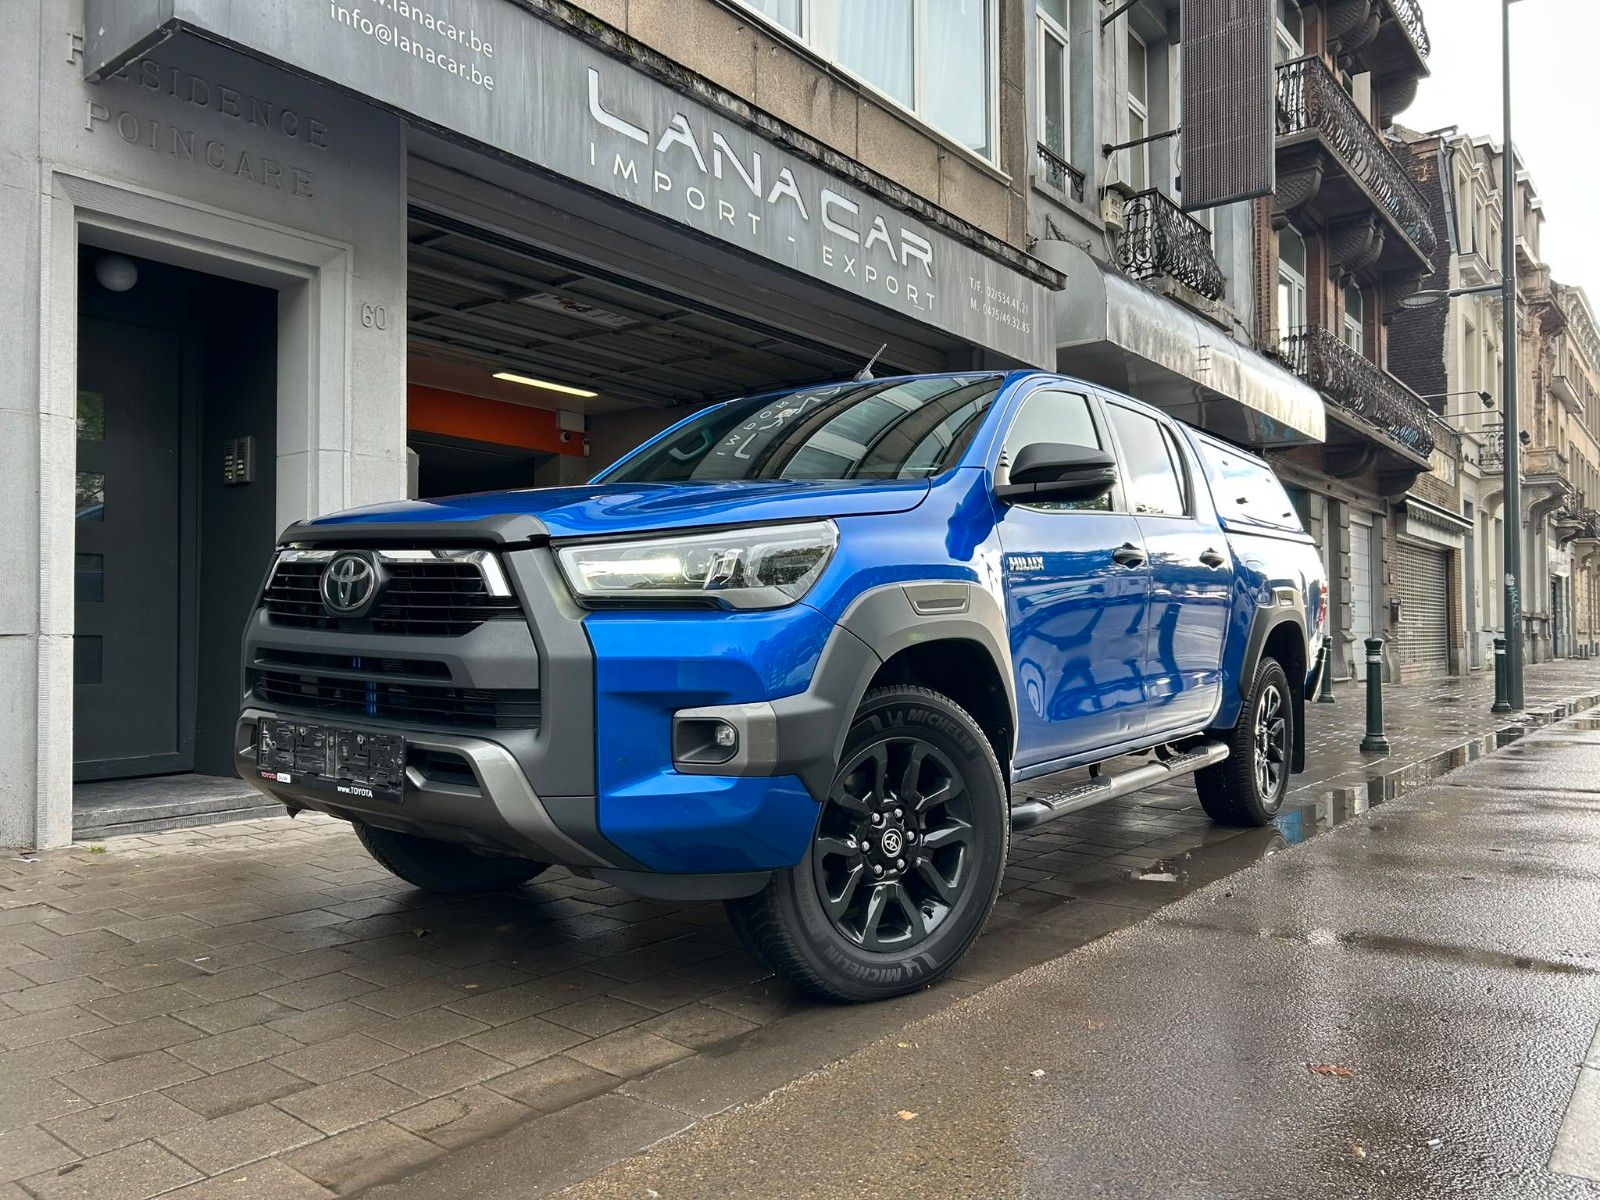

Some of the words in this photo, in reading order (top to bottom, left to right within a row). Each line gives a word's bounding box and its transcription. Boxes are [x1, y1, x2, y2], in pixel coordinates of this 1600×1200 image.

[331, 0, 493, 91] info@lanacar.be
[66, 33, 328, 151] RSIDENCE
[84, 99, 314, 199] POINCARE
[590, 142, 761, 235] IMPORT
[823, 245, 935, 310] EXPORT
[360, 302, 386, 331] 60
[907, 708, 978, 756] MICHELIN
[824, 944, 902, 983] MICHELIN
